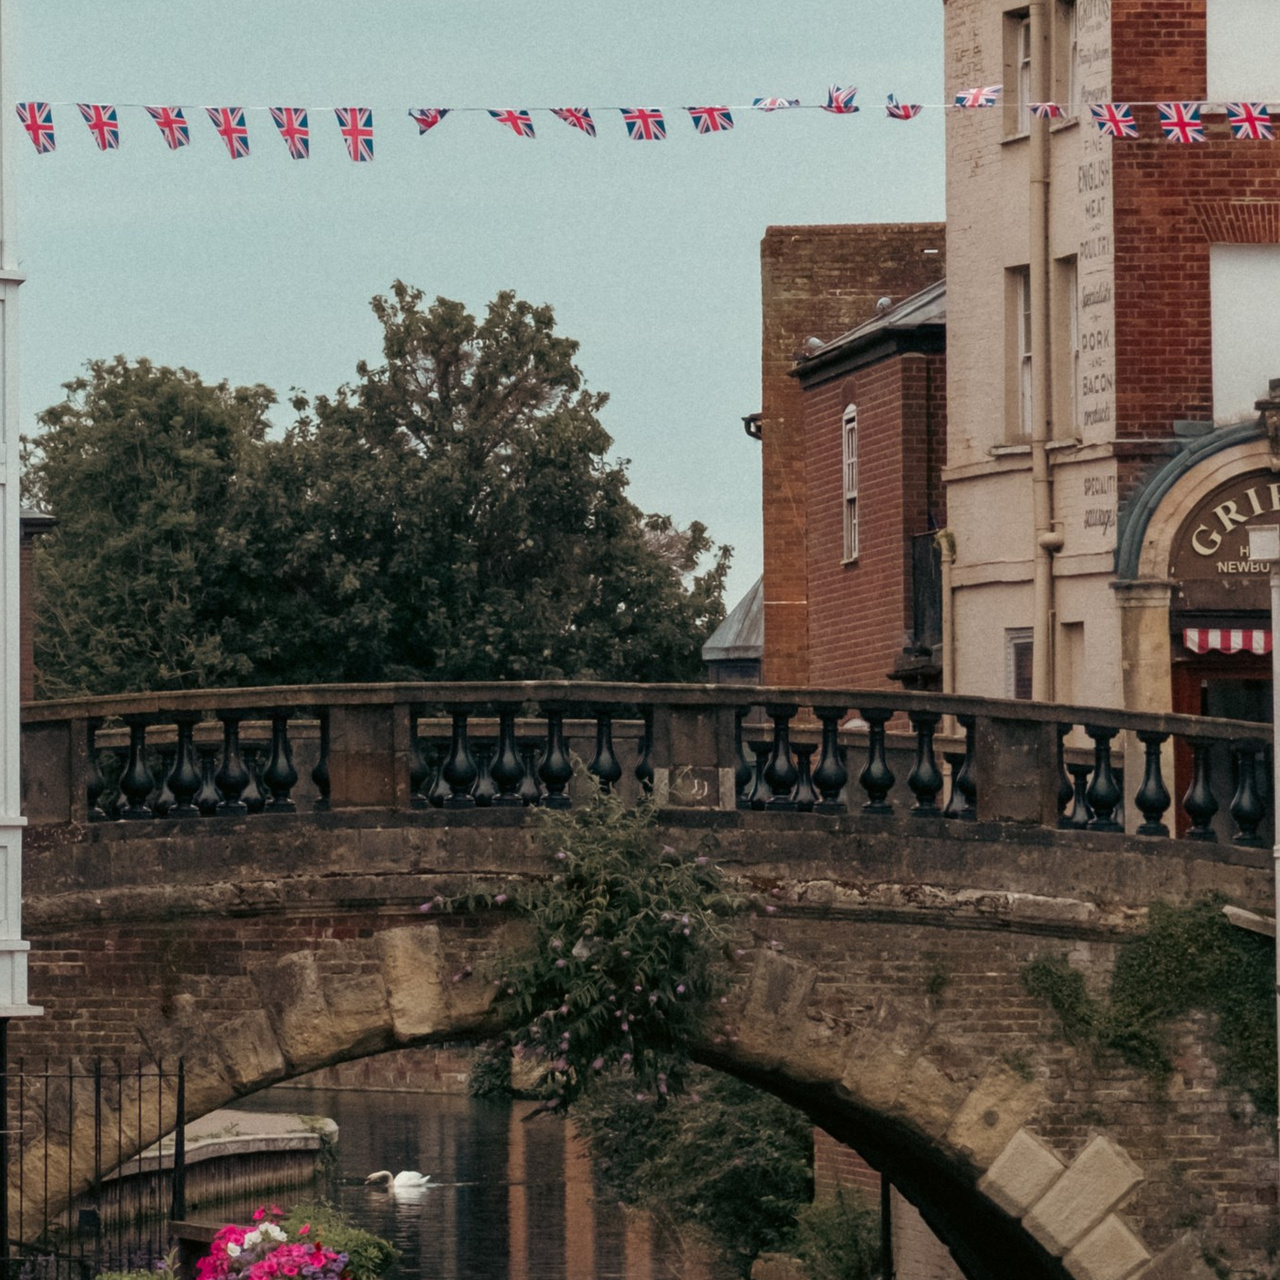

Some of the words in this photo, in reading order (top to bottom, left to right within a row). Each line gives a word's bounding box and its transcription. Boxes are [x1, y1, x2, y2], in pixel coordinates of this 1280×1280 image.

[1078, 159, 1110, 193] ENGLISH
[1085, 196, 1106, 219] MEAT
[1080, 236, 1110, 261] POULTRY
[1082, 329, 1110, 353] PORK
[1082, 373, 1113, 396] BACON
[1217, 561, 1270, 573] NEWBU
